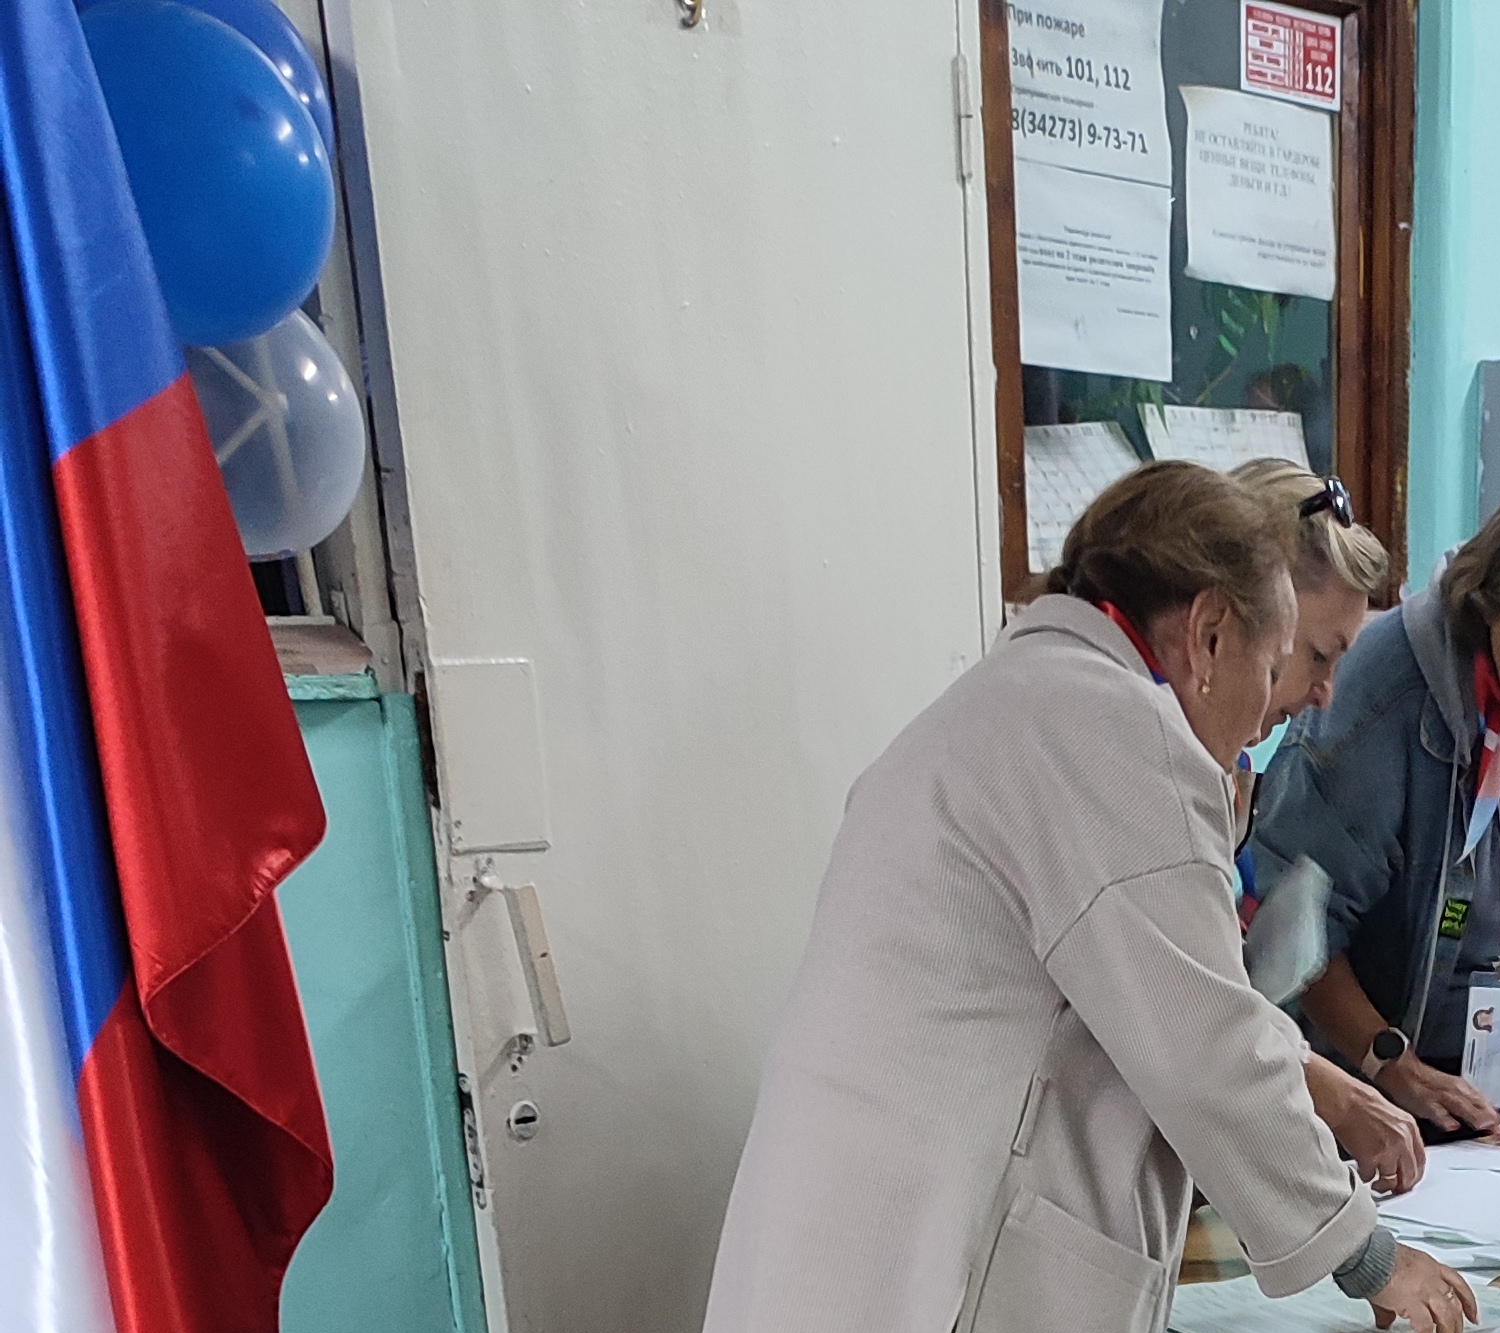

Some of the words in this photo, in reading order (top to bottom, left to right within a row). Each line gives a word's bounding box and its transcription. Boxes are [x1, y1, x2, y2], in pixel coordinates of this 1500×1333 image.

[1036, 13, 1086, 39] пожаре
[1066, 56, 1100, 88] 101,
[1104, 64, 1131, 91] 112
[1305, 62, 1334, 95] 112
[1087, 122, 1149, 155] 9-73-71
